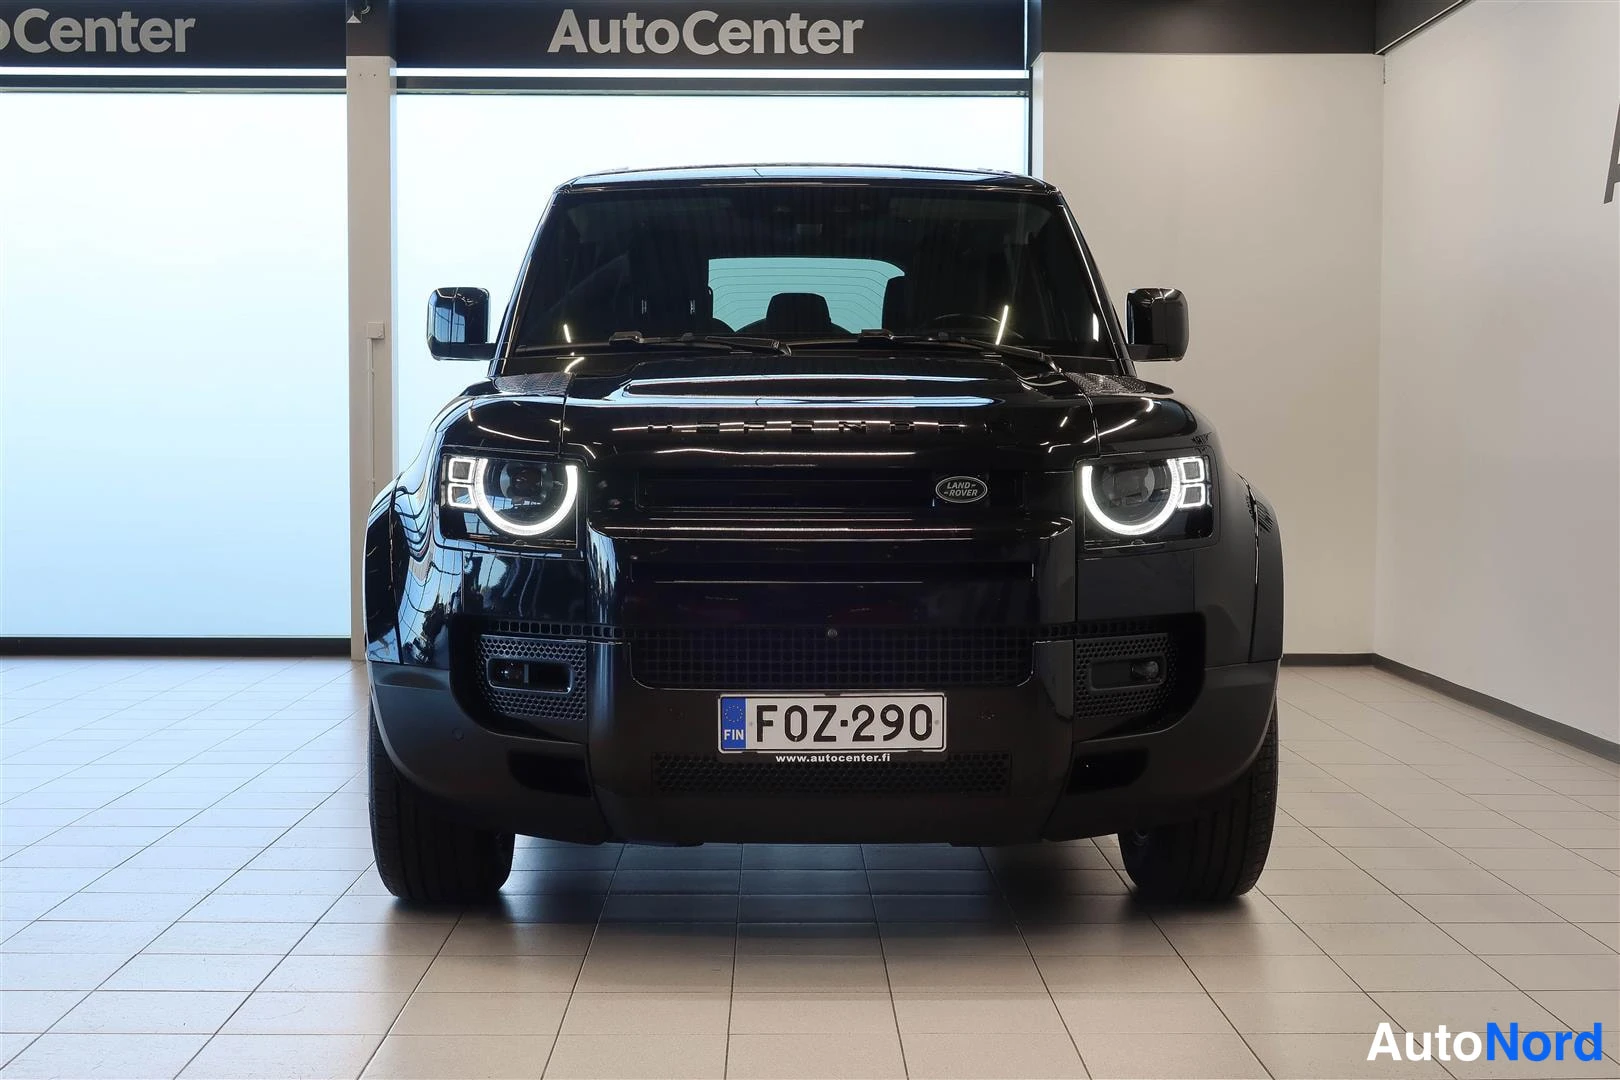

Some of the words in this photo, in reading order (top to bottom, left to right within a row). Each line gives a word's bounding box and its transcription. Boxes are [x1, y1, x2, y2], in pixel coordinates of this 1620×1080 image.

[547, 9, 864, 55] AutoCenter
[723, 729, 745, 741] FIN
[775, 753, 891, 762] www.autocenter.fi
